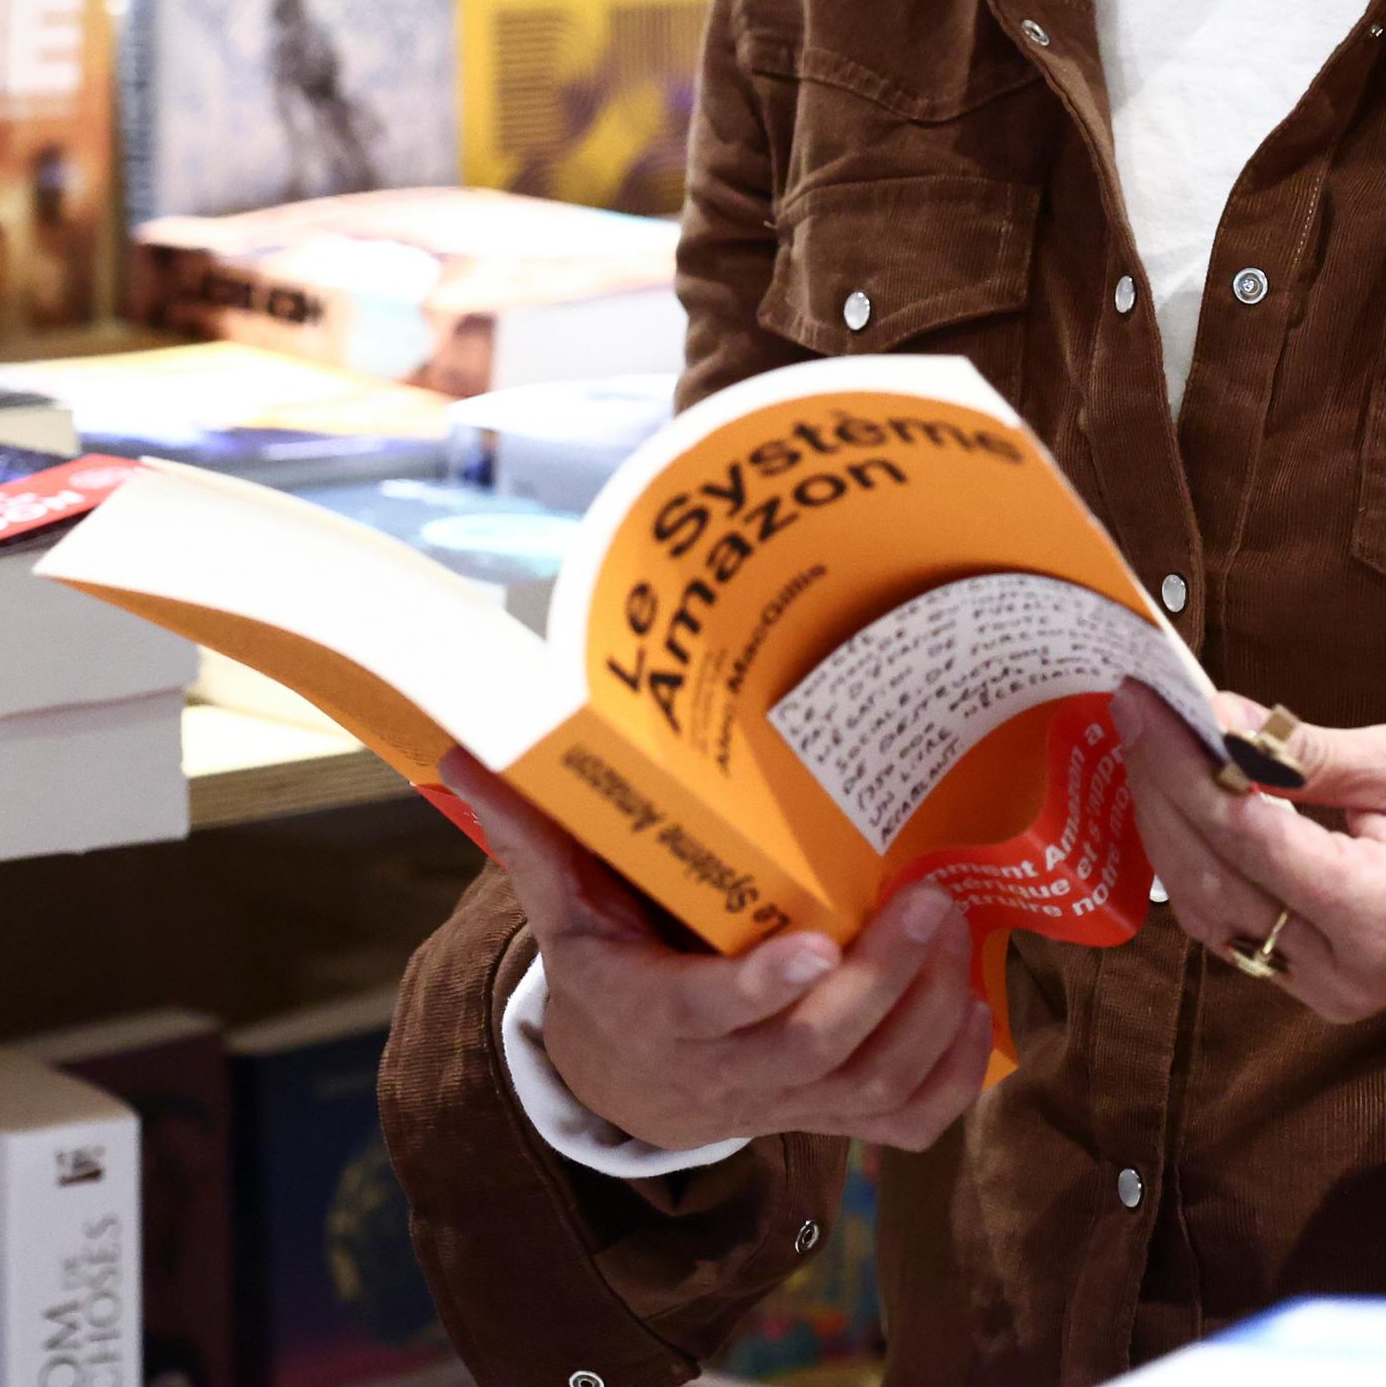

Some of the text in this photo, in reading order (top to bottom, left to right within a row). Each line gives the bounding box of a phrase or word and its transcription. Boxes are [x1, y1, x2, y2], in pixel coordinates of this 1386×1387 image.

[652, 409, 1024, 558] Système
[607, 582, 659, 693] Le
[649, 455, 909, 734] Amazon
